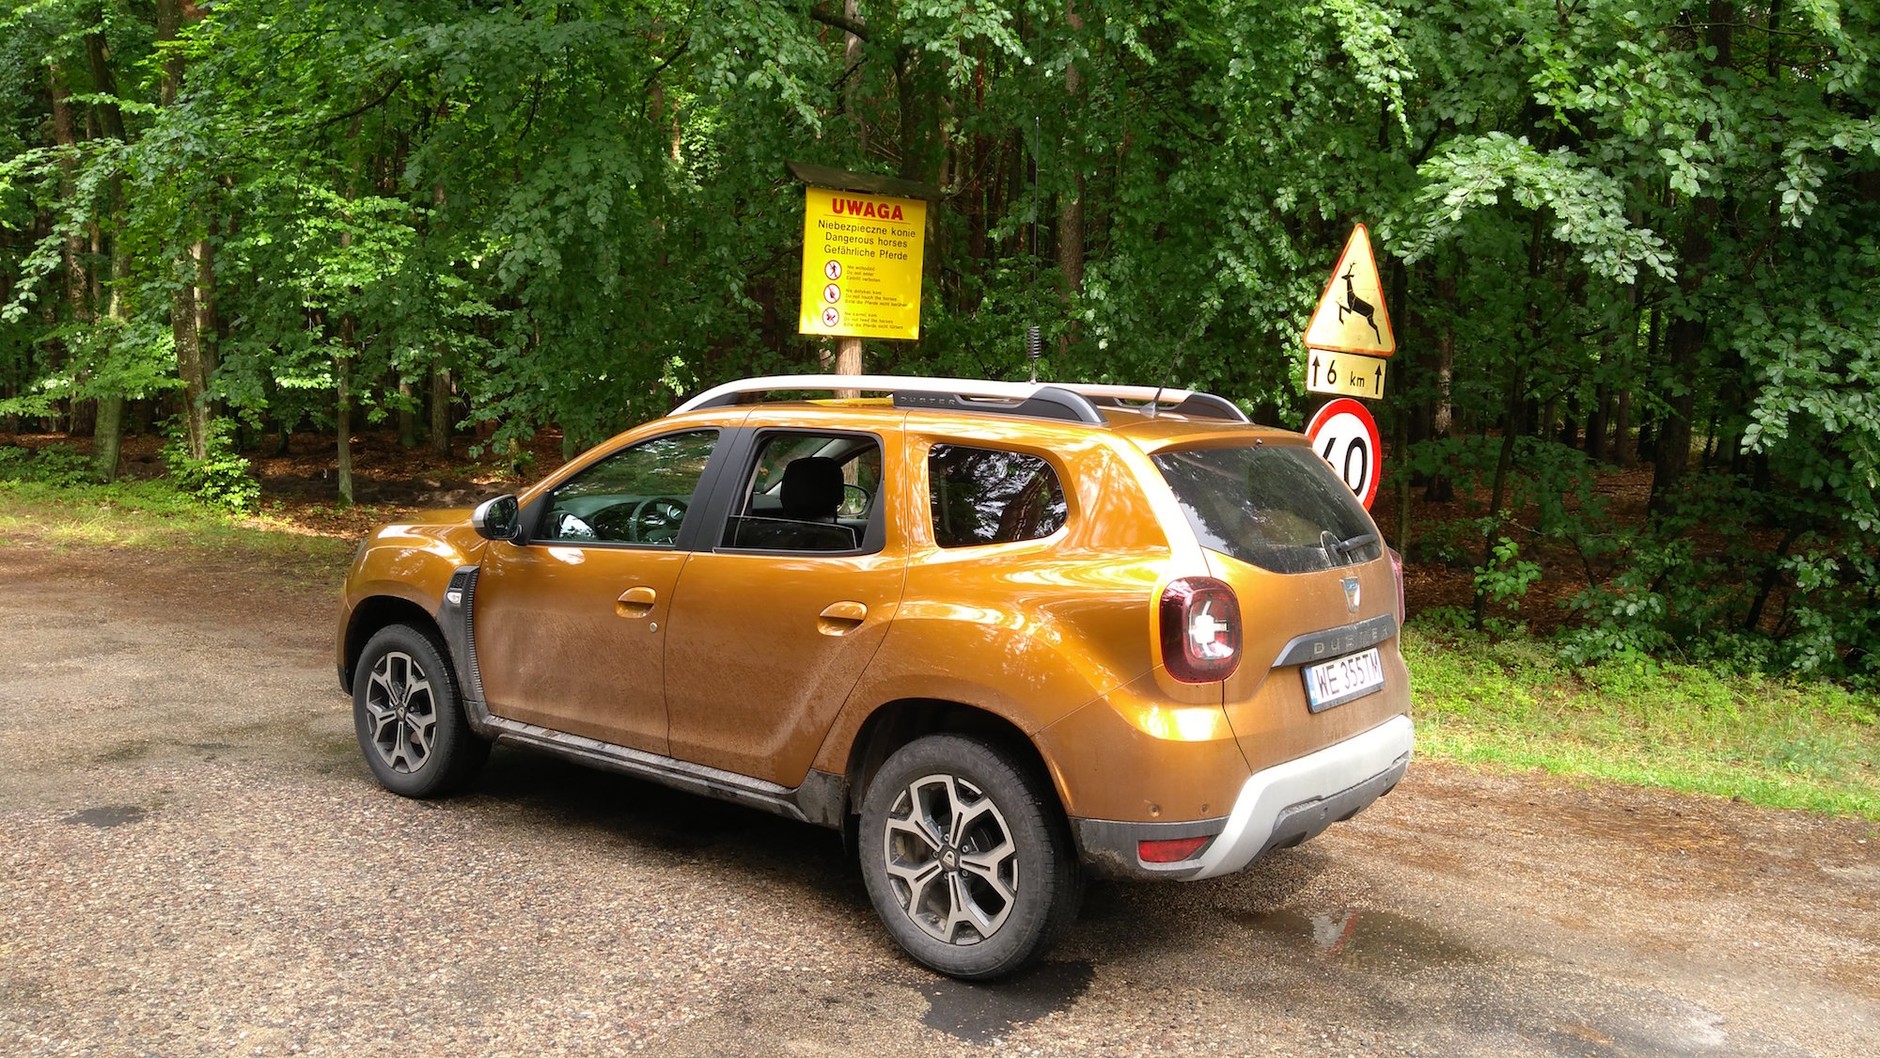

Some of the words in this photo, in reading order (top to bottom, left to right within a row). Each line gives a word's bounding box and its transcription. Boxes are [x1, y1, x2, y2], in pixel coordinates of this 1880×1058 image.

[832, 198, 904, 220] UWAGA
[818, 220, 887, 234] Niebezpieczne
[892, 227, 916, 237] konie
[825, 232, 874, 245] Dangerous
[878, 237, 907, 248] horses
[824, 244, 875, 257] Gefährliche
[879, 250, 908, 260] Pferde
[1327, 360, 1337, 385] 6
[1350, 371, 1365, 387] km
[1313, 625, 1388, 655] DUSTER
[1315, 664, 1340, 699] WE
[1340, 651, 1381, 690] 355TM
